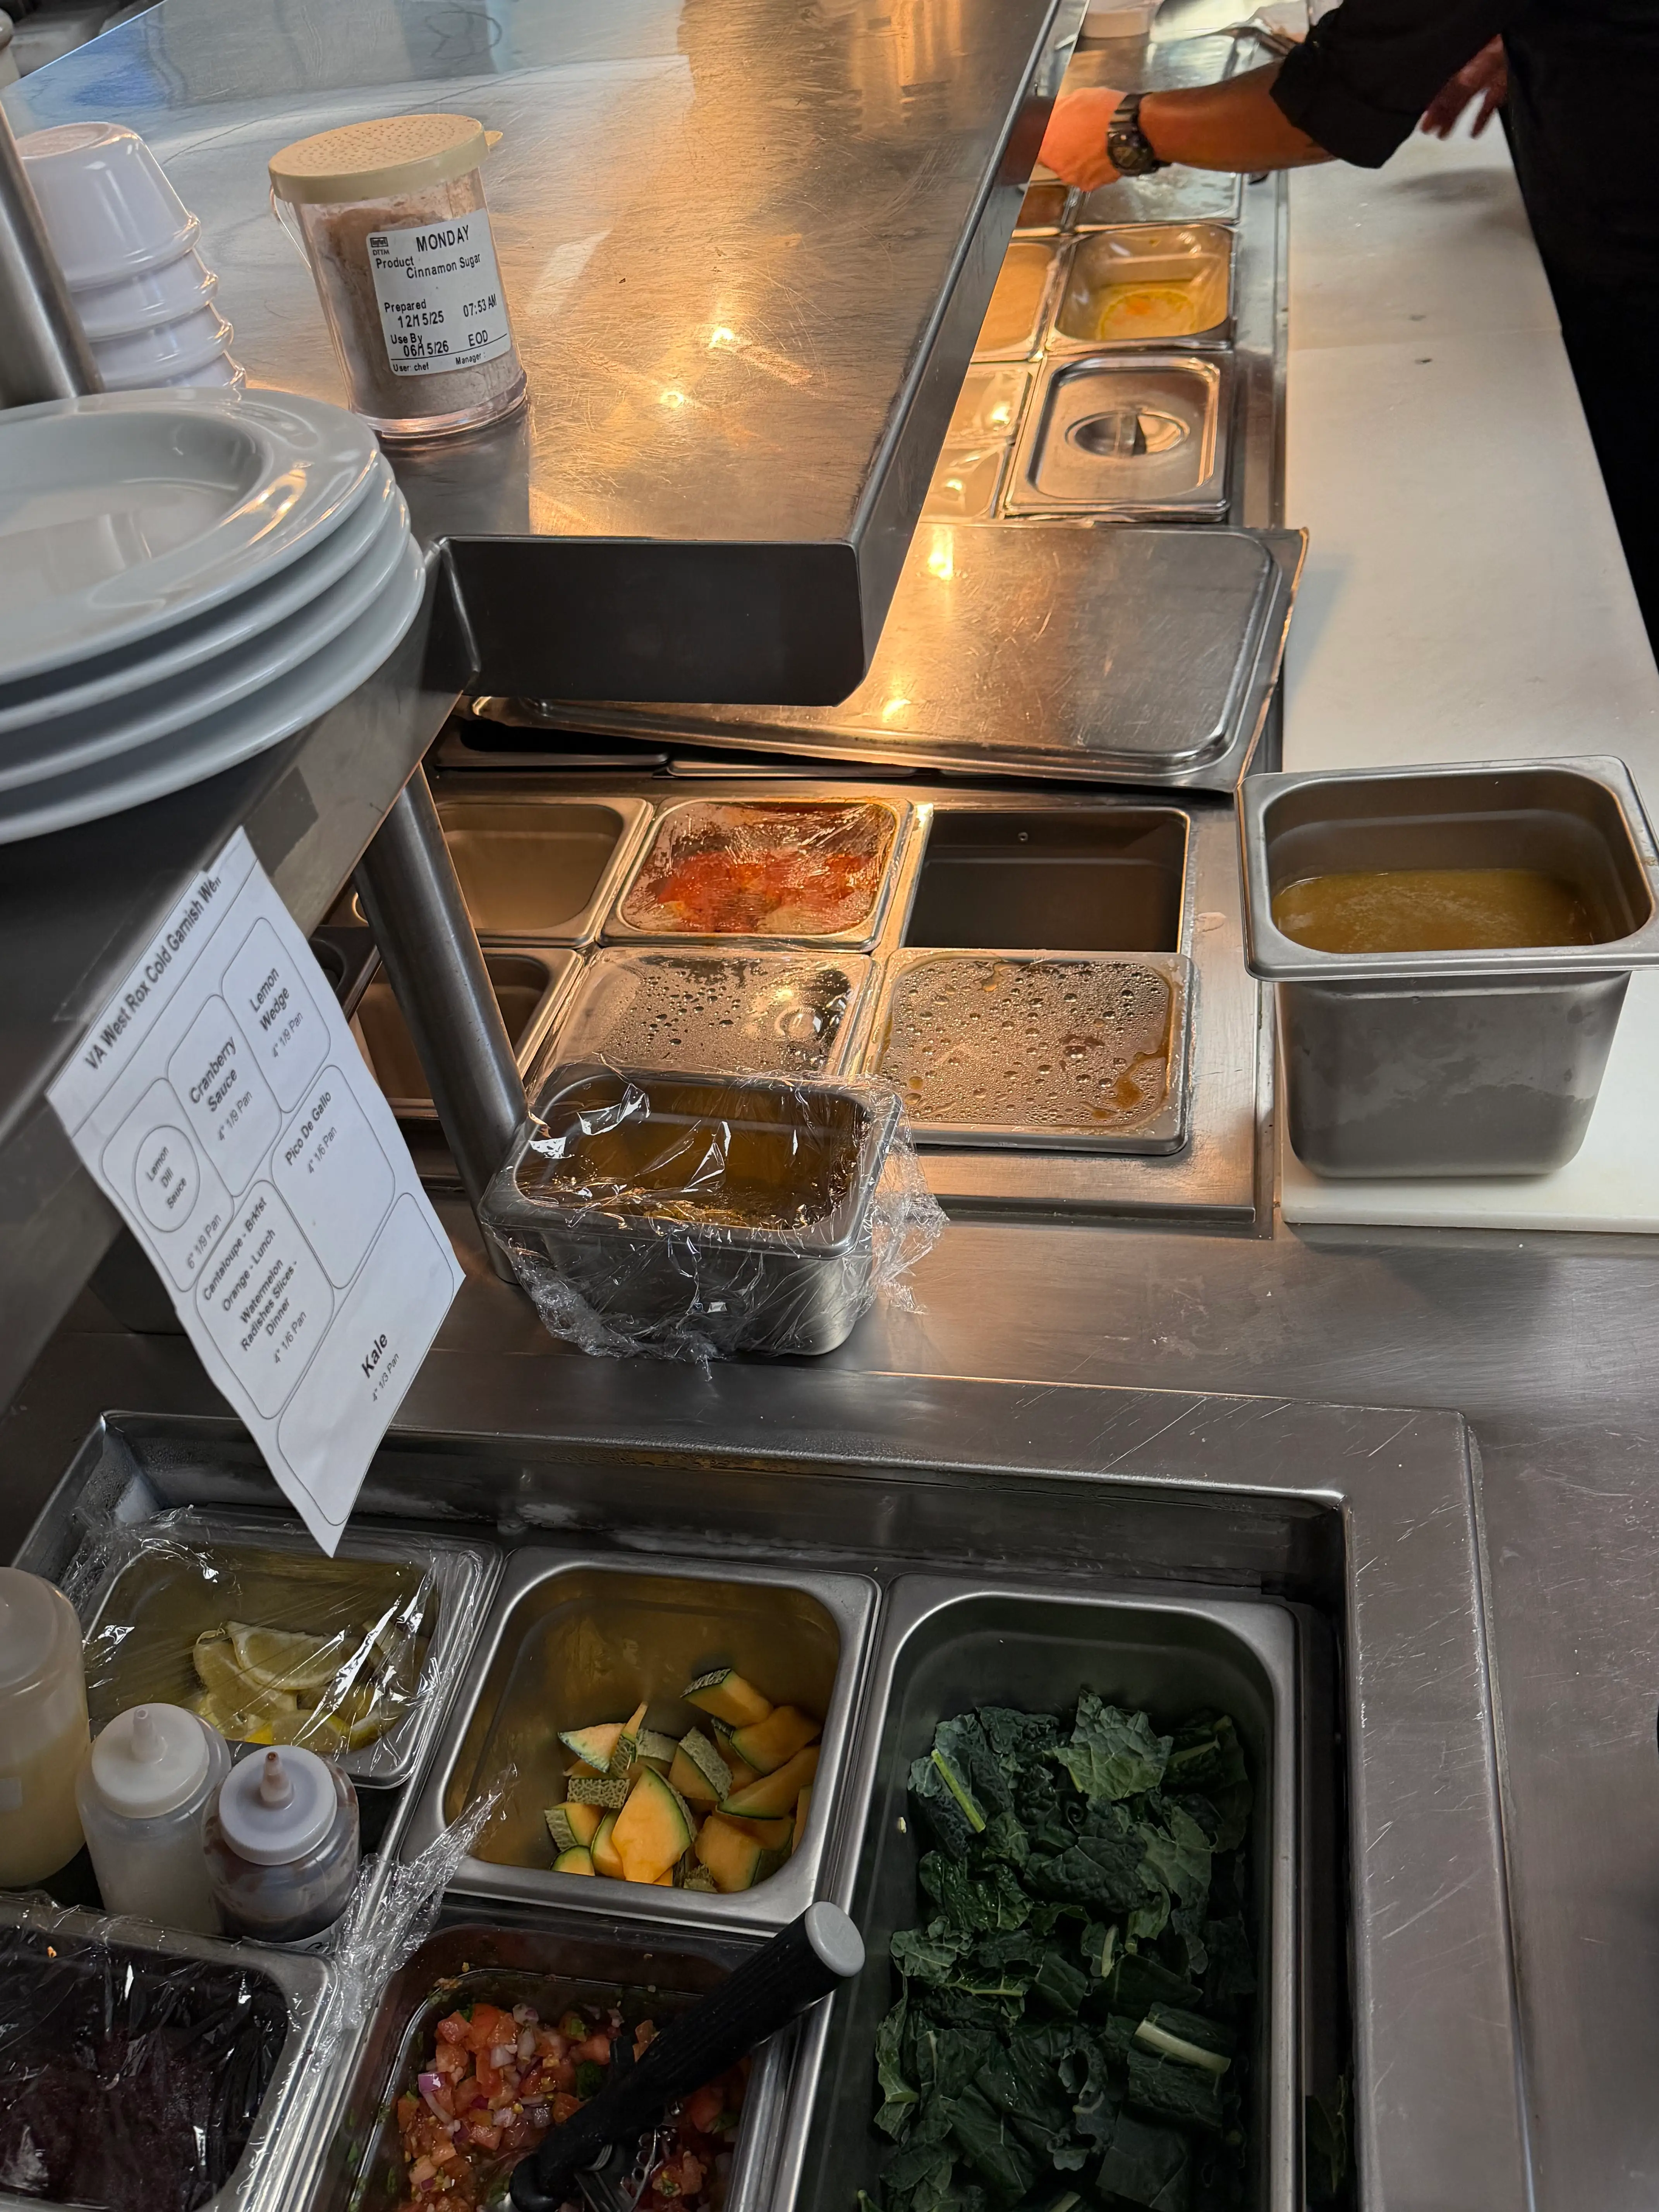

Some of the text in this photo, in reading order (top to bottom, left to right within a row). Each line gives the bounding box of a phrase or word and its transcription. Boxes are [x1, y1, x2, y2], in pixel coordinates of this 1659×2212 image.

[416, 225, 469, 252] MONDAY
[376, 256, 414, 269] Product
[406, 254, 481, 279] Cinnamon Sugar
[384, 299, 427, 314] Prepared
[398, 293, 497, 328] 12/15/25 07:53 AM
[390, 333, 422, 345] Use By
[403, 330, 488, 357] 06/15/26 EOD
[414, 362, 429, 371] chef
[455, 353, 481, 365] Manager
[84, 1044, 108, 1070] VA
[100, 1007, 132, 1048] West
[125, 981, 151, 1014] Rox
[144, 945, 172, 983] Cold
[167, 899, 204, 951] Garnish
[249, 968, 280, 1013] Lemon
[259, 987, 290, 1032] Wedge
[278, 1027, 291, 1047] 1/9
[290, 1012, 304, 1031] Pan
[189, 1036, 236, 1104] Cranberry
[208, 1069, 237, 1112] Sauce
[224, 1110, 239, 1129] 1/9
[237, 1090, 253, 1114] Pan
[285, 1092, 331, 1166] Pico De Gallo
[314, 1144, 326, 1162] 1/6
[323, 1127, 337, 1148] Pan
[146, 1146, 169, 1182] Lemon
[161, 1167, 173, 1188] Dill
[166, 1177, 187, 1209] Sauce
[196, 1235, 208, 1255] 1/9
[205, 1214, 222, 1238] Pan
[203, 1237, 244, 1302] Cantaloupe
[245, 1197, 267, 1233] Brkfst
[222, 1269, 251, 1312] Orange
[251, 1228, 276, 1265] Lunch
[239, 1259, 283, 1324] Watermelon
[241, 1300, 275, 1352] Radishes
[273, 1265, 295, 1299] Slices
[266, 1297, 290, 1337] Dinner
[282, 1333, 294, 1350] 1/6
[292, 1311, 307, 1334] Pan
[361, 1334, 388, 1379] Kale
[379, 1372, 389, 1388] 1/3
[387, 1353, 400, 1374] Pan
